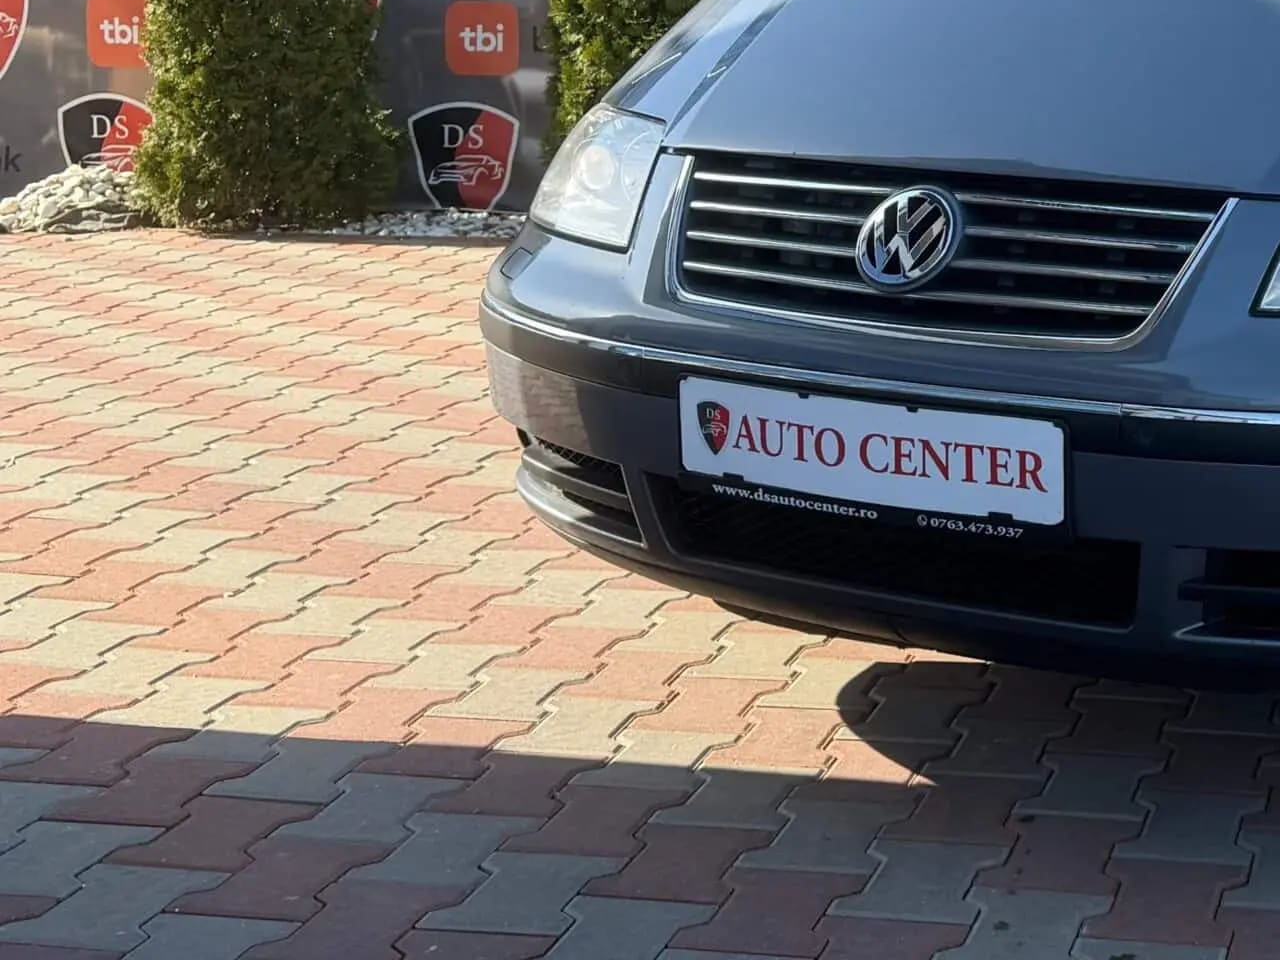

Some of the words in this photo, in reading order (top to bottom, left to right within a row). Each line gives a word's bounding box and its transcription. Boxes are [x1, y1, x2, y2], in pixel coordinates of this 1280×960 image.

[99, 15, 140, 45] tbi
[459, 23, 504, 53] tbi
[90, 114, 129, 139] DS
[441, 123, 485, 149] DS
[732, 413, 846, 468] AUTO
[859, 432, 1049, 493] CENTER
[712, 483, 878, 520] www.dsautocenter.ro
[930, 517, 1023, 539] 0763.473.937
